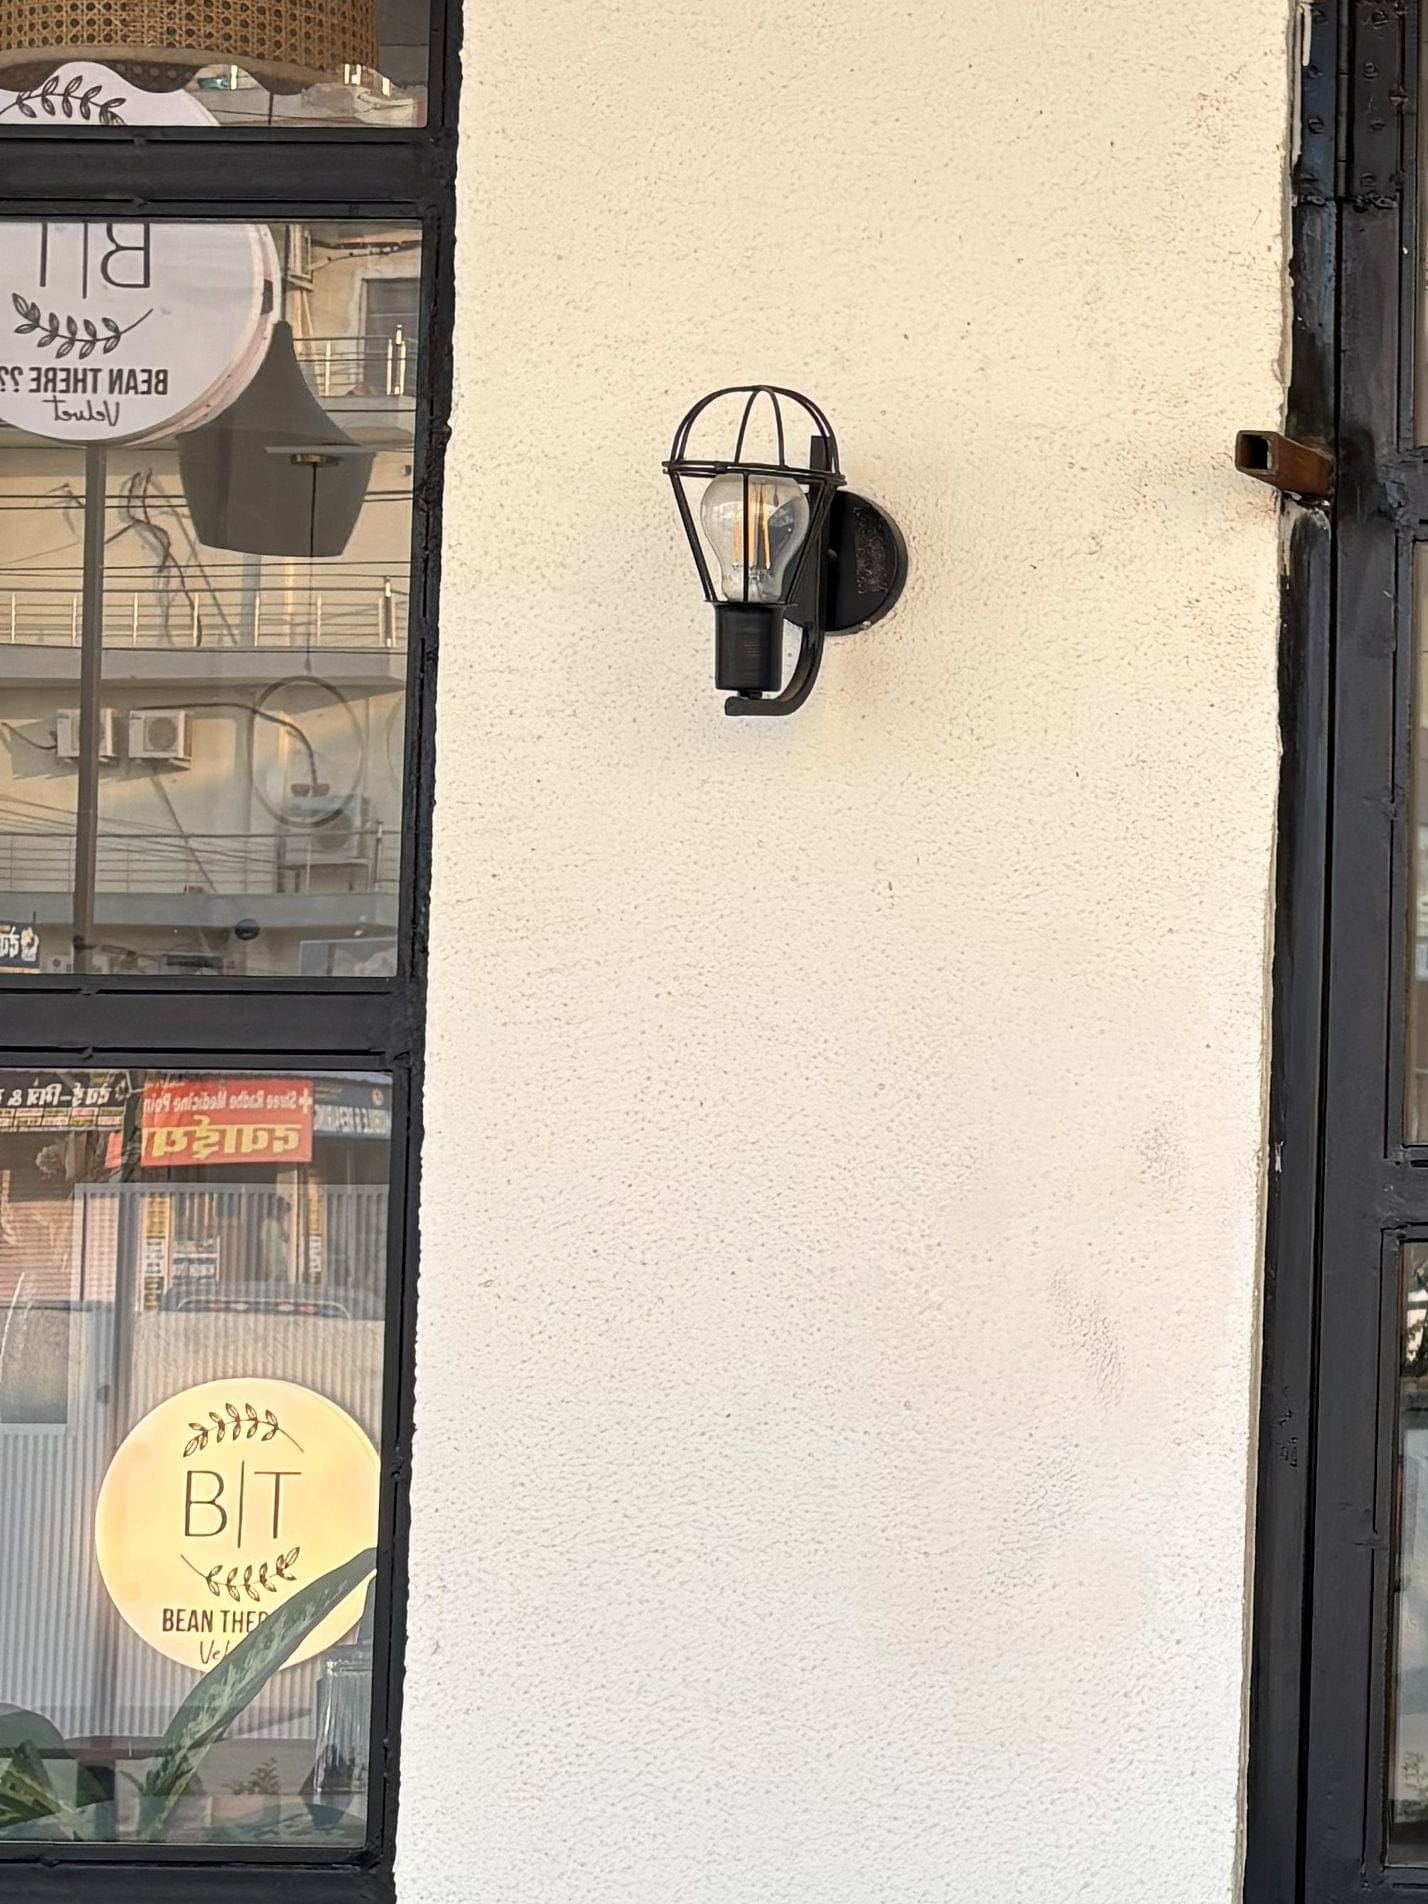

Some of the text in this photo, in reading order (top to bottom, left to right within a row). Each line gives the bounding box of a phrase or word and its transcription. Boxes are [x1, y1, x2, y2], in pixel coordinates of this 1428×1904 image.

[161, 1608, 269, 1633] BEAN THE
[199, 1640, 231, 1665] Vel
